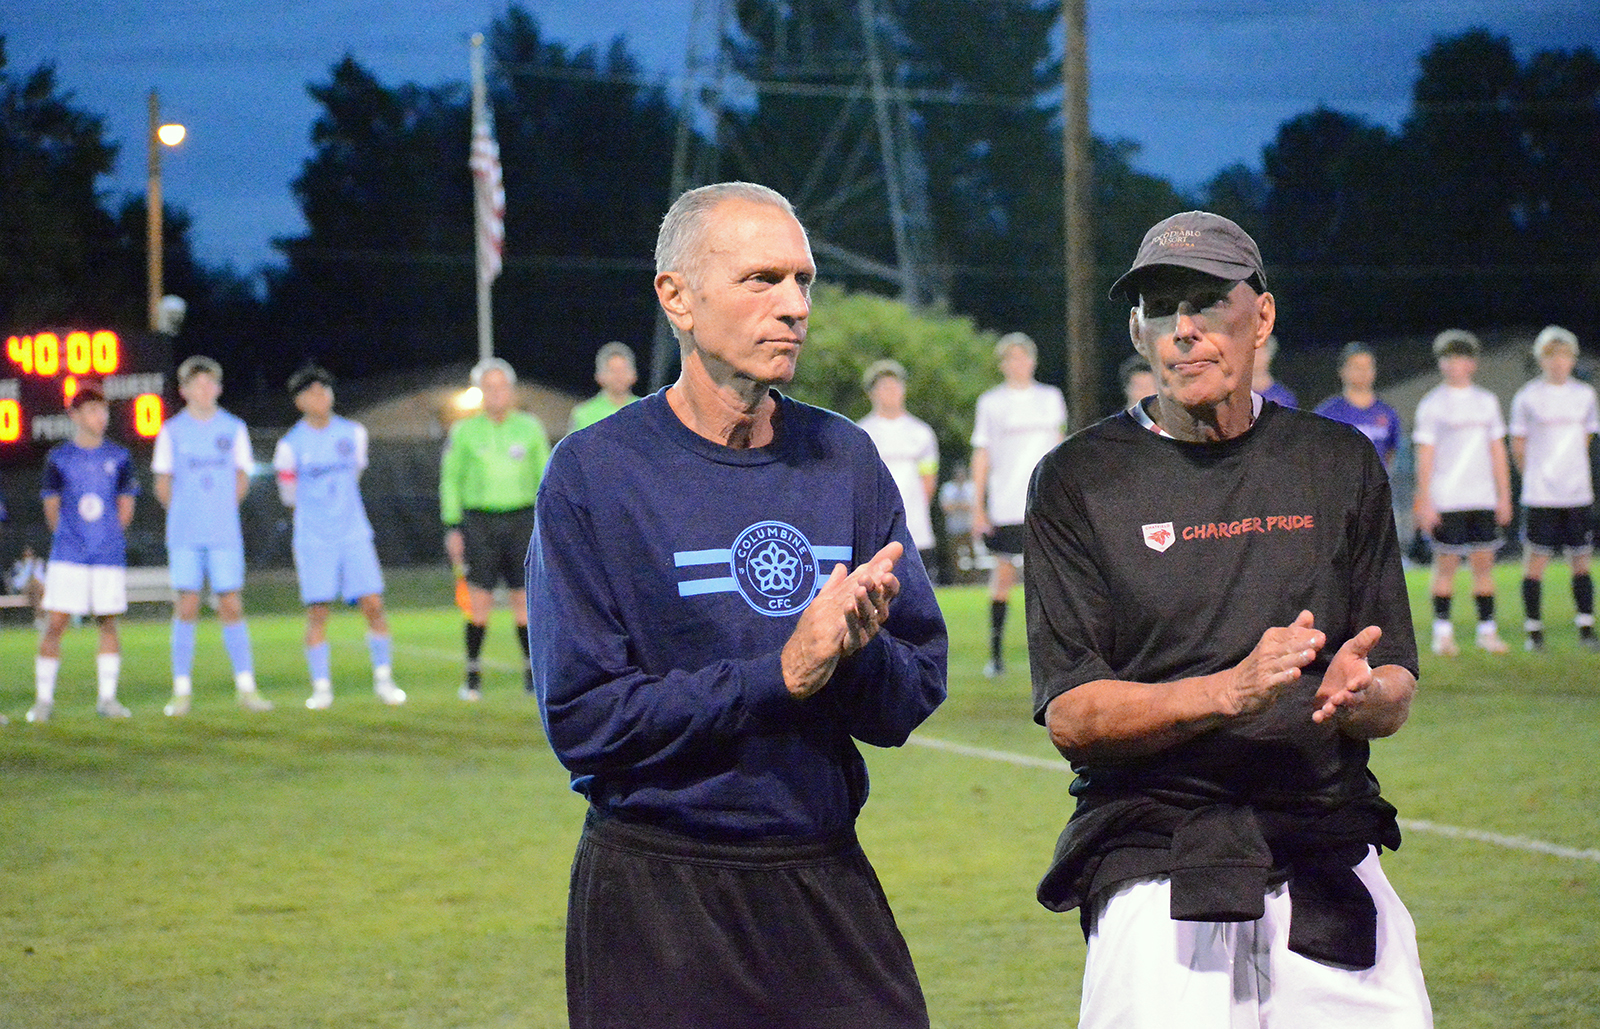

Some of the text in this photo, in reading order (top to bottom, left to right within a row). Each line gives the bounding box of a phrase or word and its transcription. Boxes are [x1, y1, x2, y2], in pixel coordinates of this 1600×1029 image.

[134, 392, 164, 439] 0
[1182, 514, 1315, 541] CHARGER PRIDE
[738, 527, 807, 558] COLUMBINE
[768, 598, 792, 609] CFC
